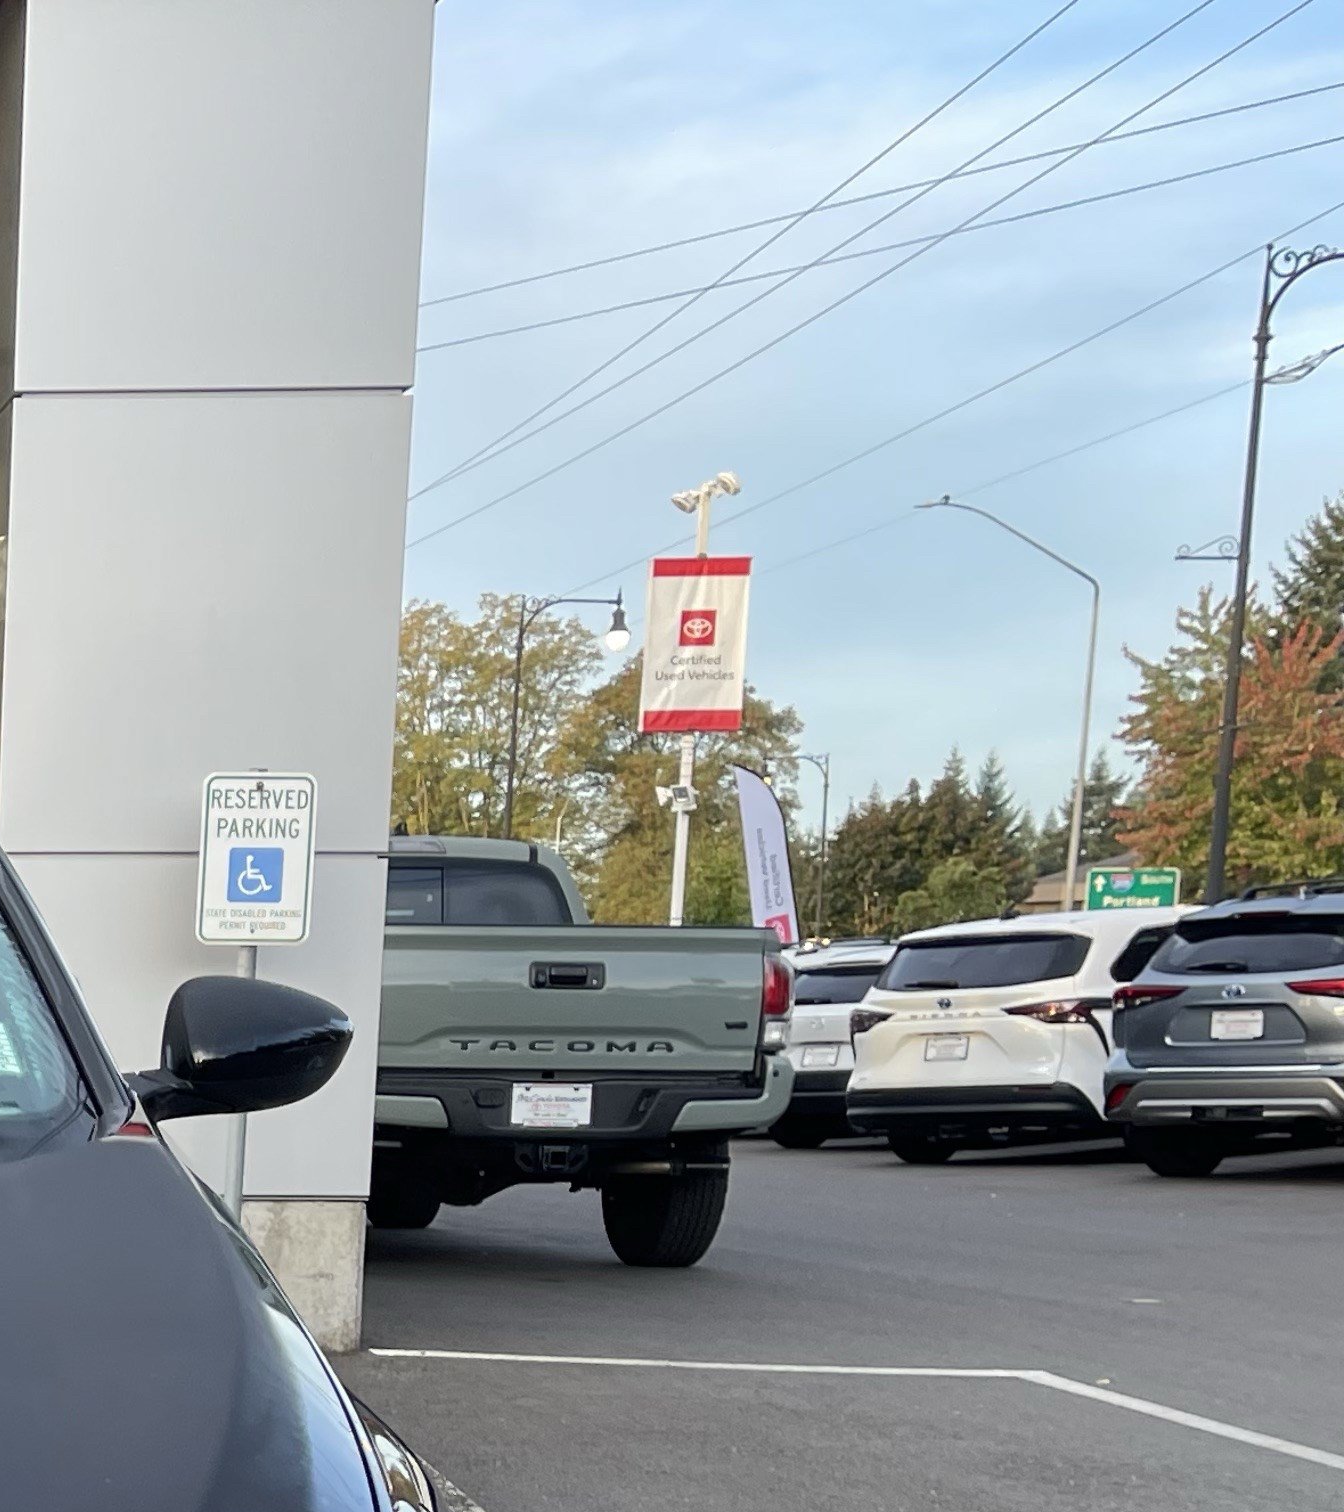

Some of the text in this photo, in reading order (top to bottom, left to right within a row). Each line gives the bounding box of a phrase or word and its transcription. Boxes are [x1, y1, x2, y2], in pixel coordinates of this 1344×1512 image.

[670, 655, 722, 666] Certified
[655, 669, 735, 681] Used Vehicles
[211, 789, 309, 810] RESERVED
[216, 817, 301, 839] PARKING
[230, 908, 267, 918] DISABLED
[269, 908, 302, 918] PARKING
[218, 921, 286, 931] PERMIT REQUIRED
[449, 1039, 674, 1053] TACOMA
